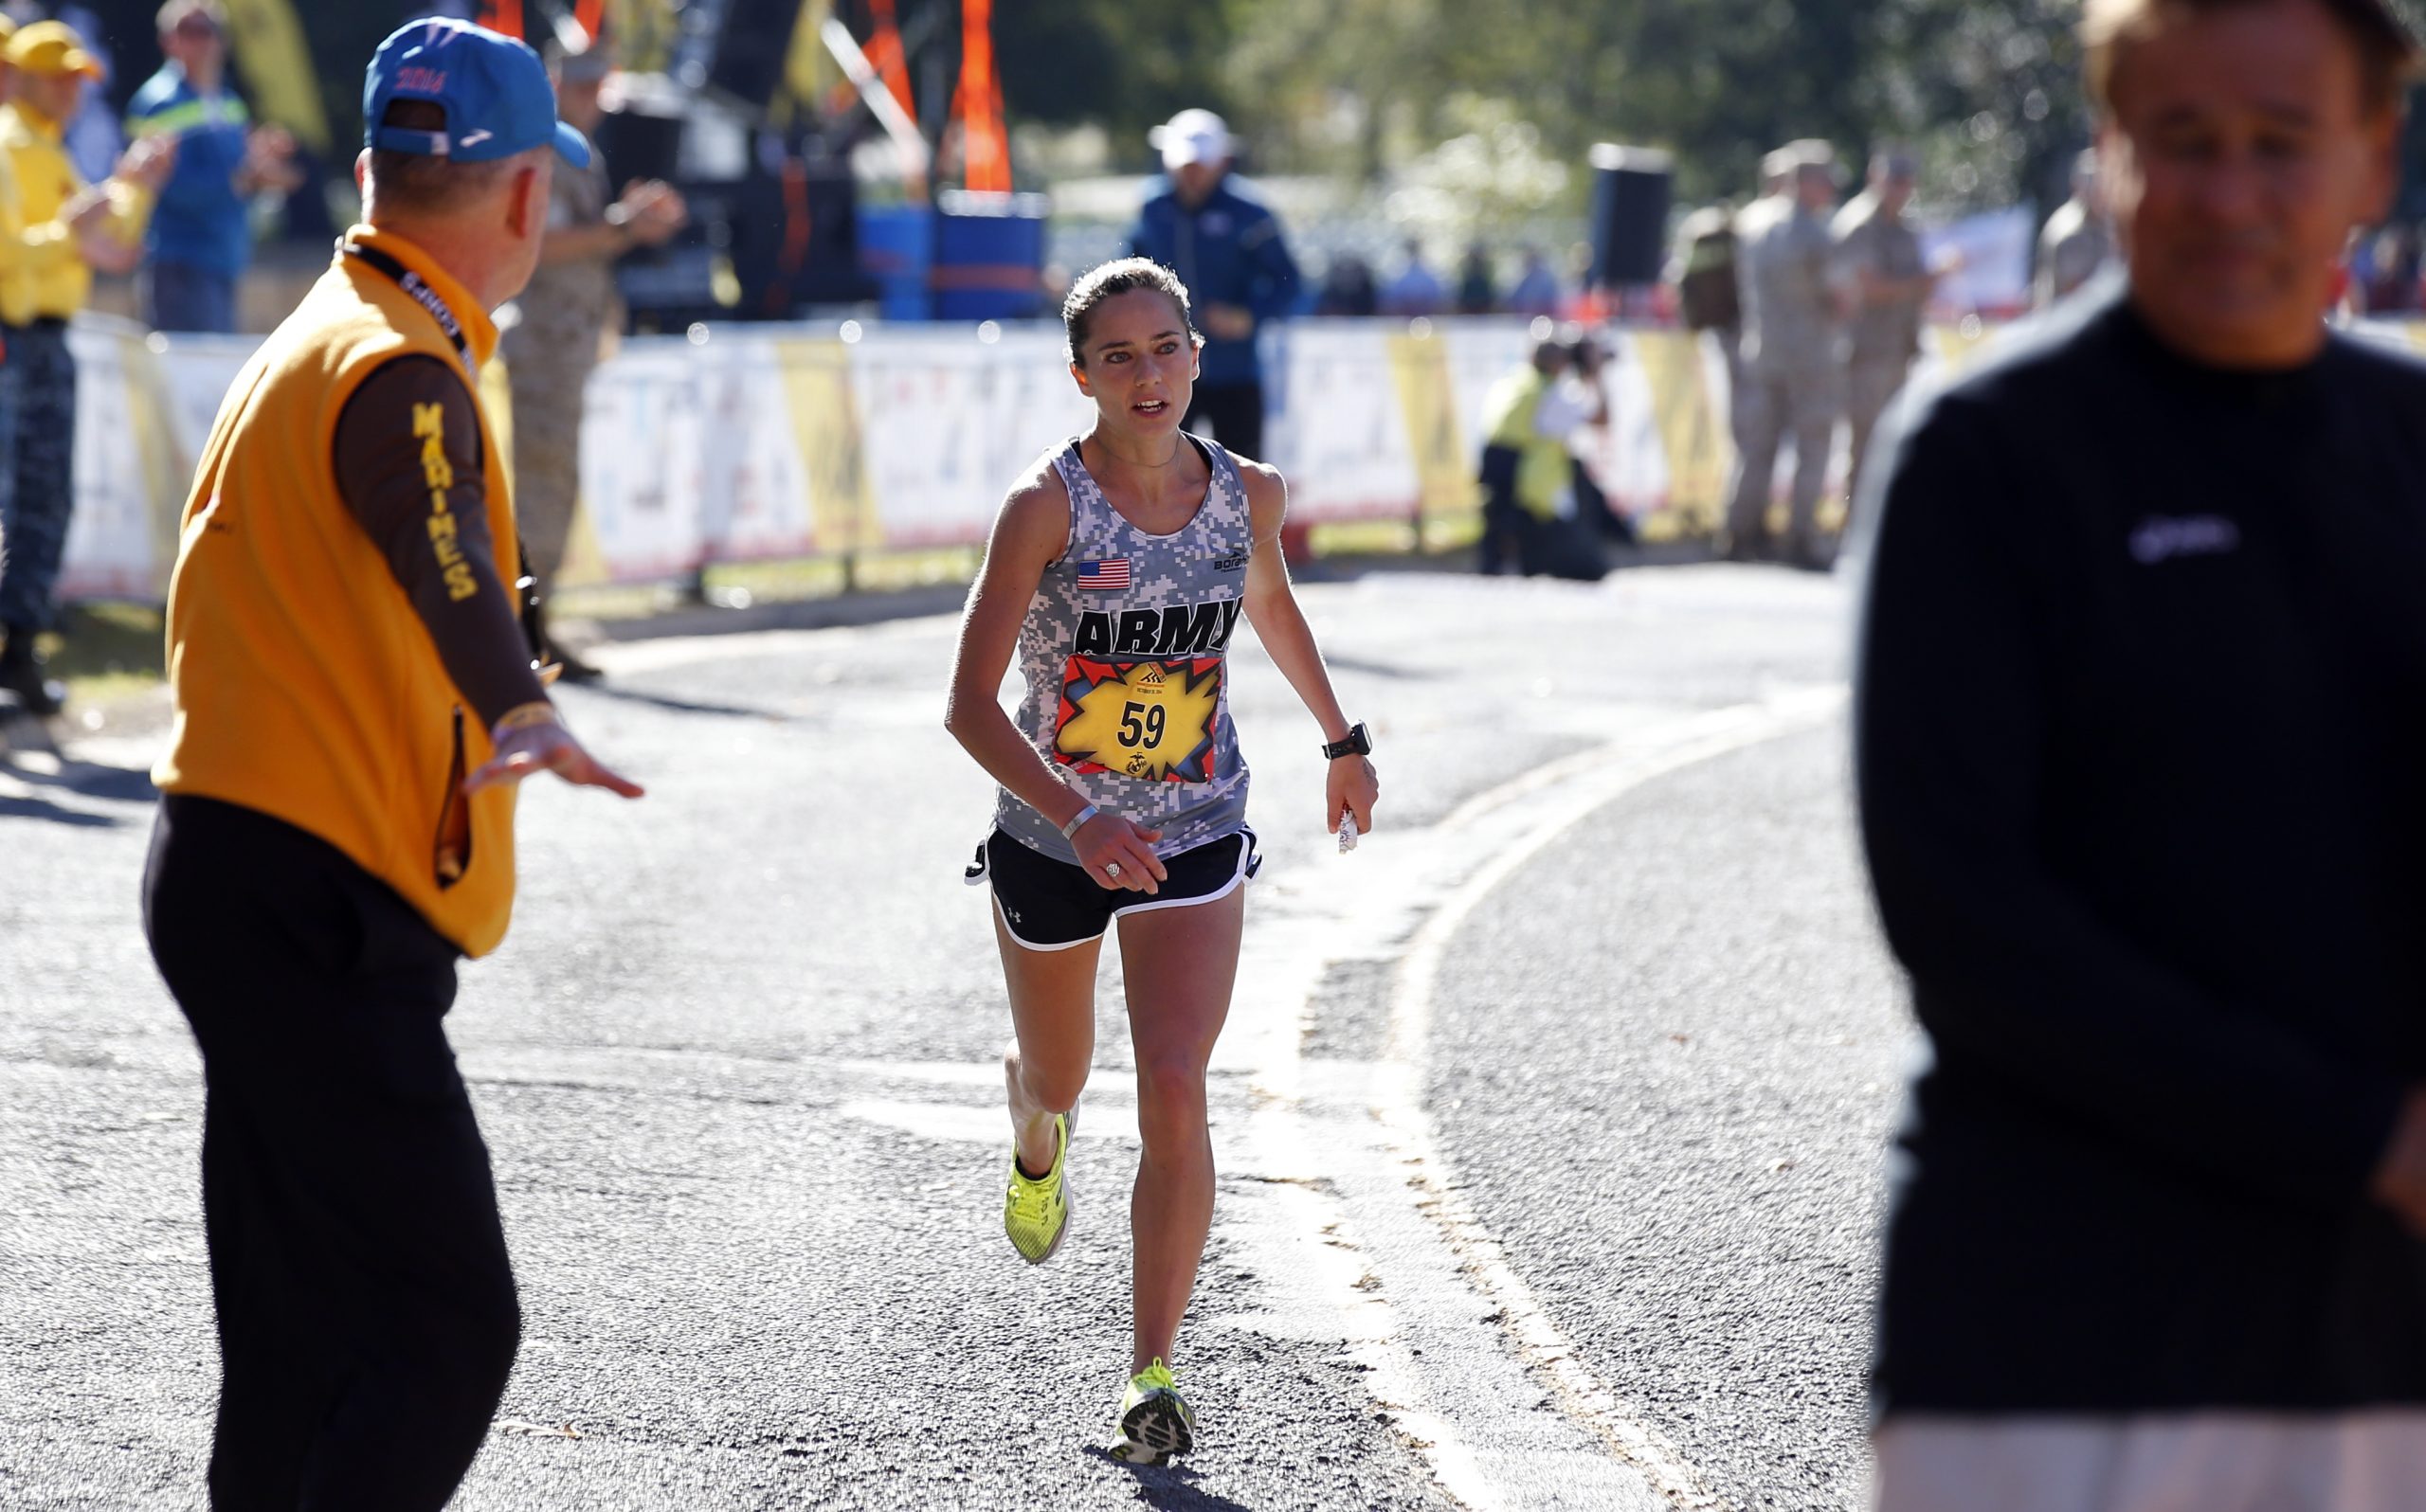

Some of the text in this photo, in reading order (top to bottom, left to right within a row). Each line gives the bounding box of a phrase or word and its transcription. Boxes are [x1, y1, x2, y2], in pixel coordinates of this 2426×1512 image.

[400, 271, 461, 337] CORPS
[411, 402, 479, 602] MARINES
[1073, 595, 1244, 656] ARMY
[1116, 699, 1167, 750] 59
